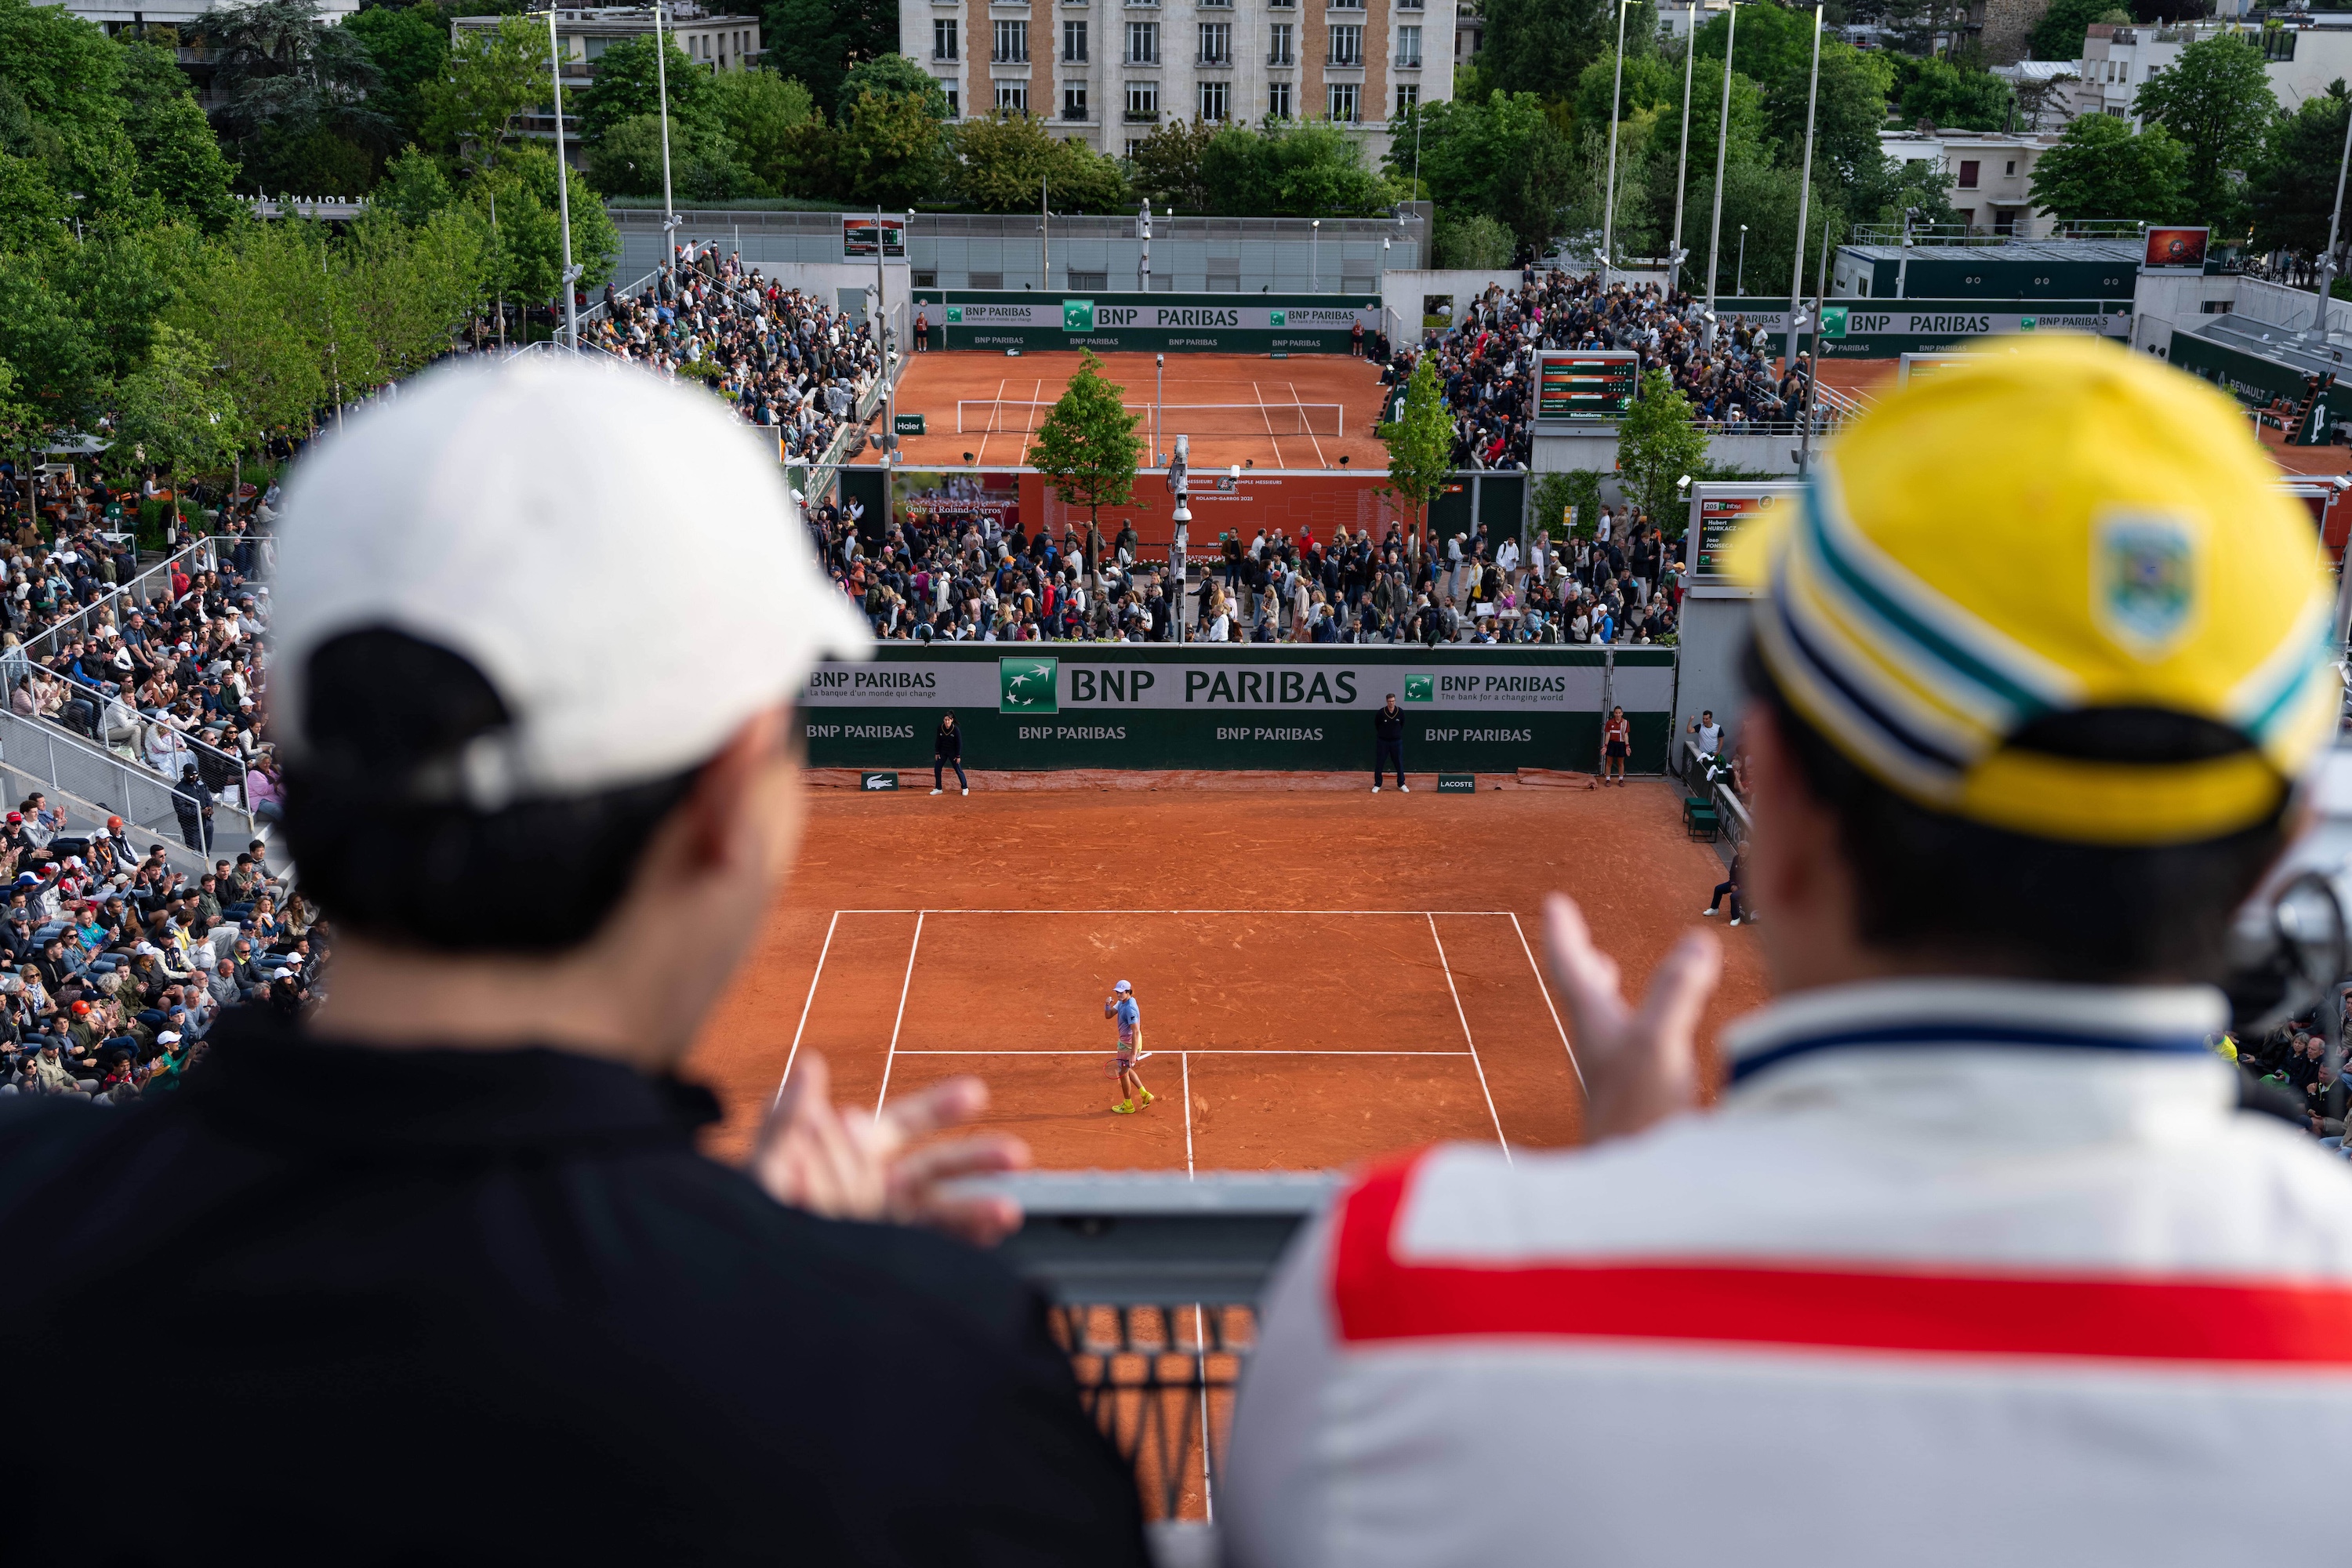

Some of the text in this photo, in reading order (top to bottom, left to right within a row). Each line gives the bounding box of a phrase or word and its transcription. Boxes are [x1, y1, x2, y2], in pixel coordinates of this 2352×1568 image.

[965, 307, 1031, 316] BNP PARIBAS
[1098, 309, 1238, 326] BNP PARIBAS
[1289, 311, 1354, 320] BNP PARIBAS
[1716, 314, 1780, 323] BNP ARIBAS
[1851, 315, 1989, 332] BNP PARIBAS
[2039, 317, 2108, 326] BNP PARIBAS
[2230, 379, 2265, 400] RENAULT
[906, 505, 927, 514] Only
[810, 672, 936, 688] BNP PARIBAS
[1071, 670, 1357, 703] BNP PARIBAS
[1441, 676, 1565, 692] BNP PARIBAS
[910, 690, 936, 698] change
[1501, 694, 1537, 702] changing
[806, 725, 914, 738] BNP PARIBAS
[1019, 726, 1126, 739] BNP PARIBAS
[1217, 727, 1323, 740] BNP PARIBAS
[1425, 729, 1531, 741] BNP PARIBAS
[1711, 786, 1741, 846] Emirates
